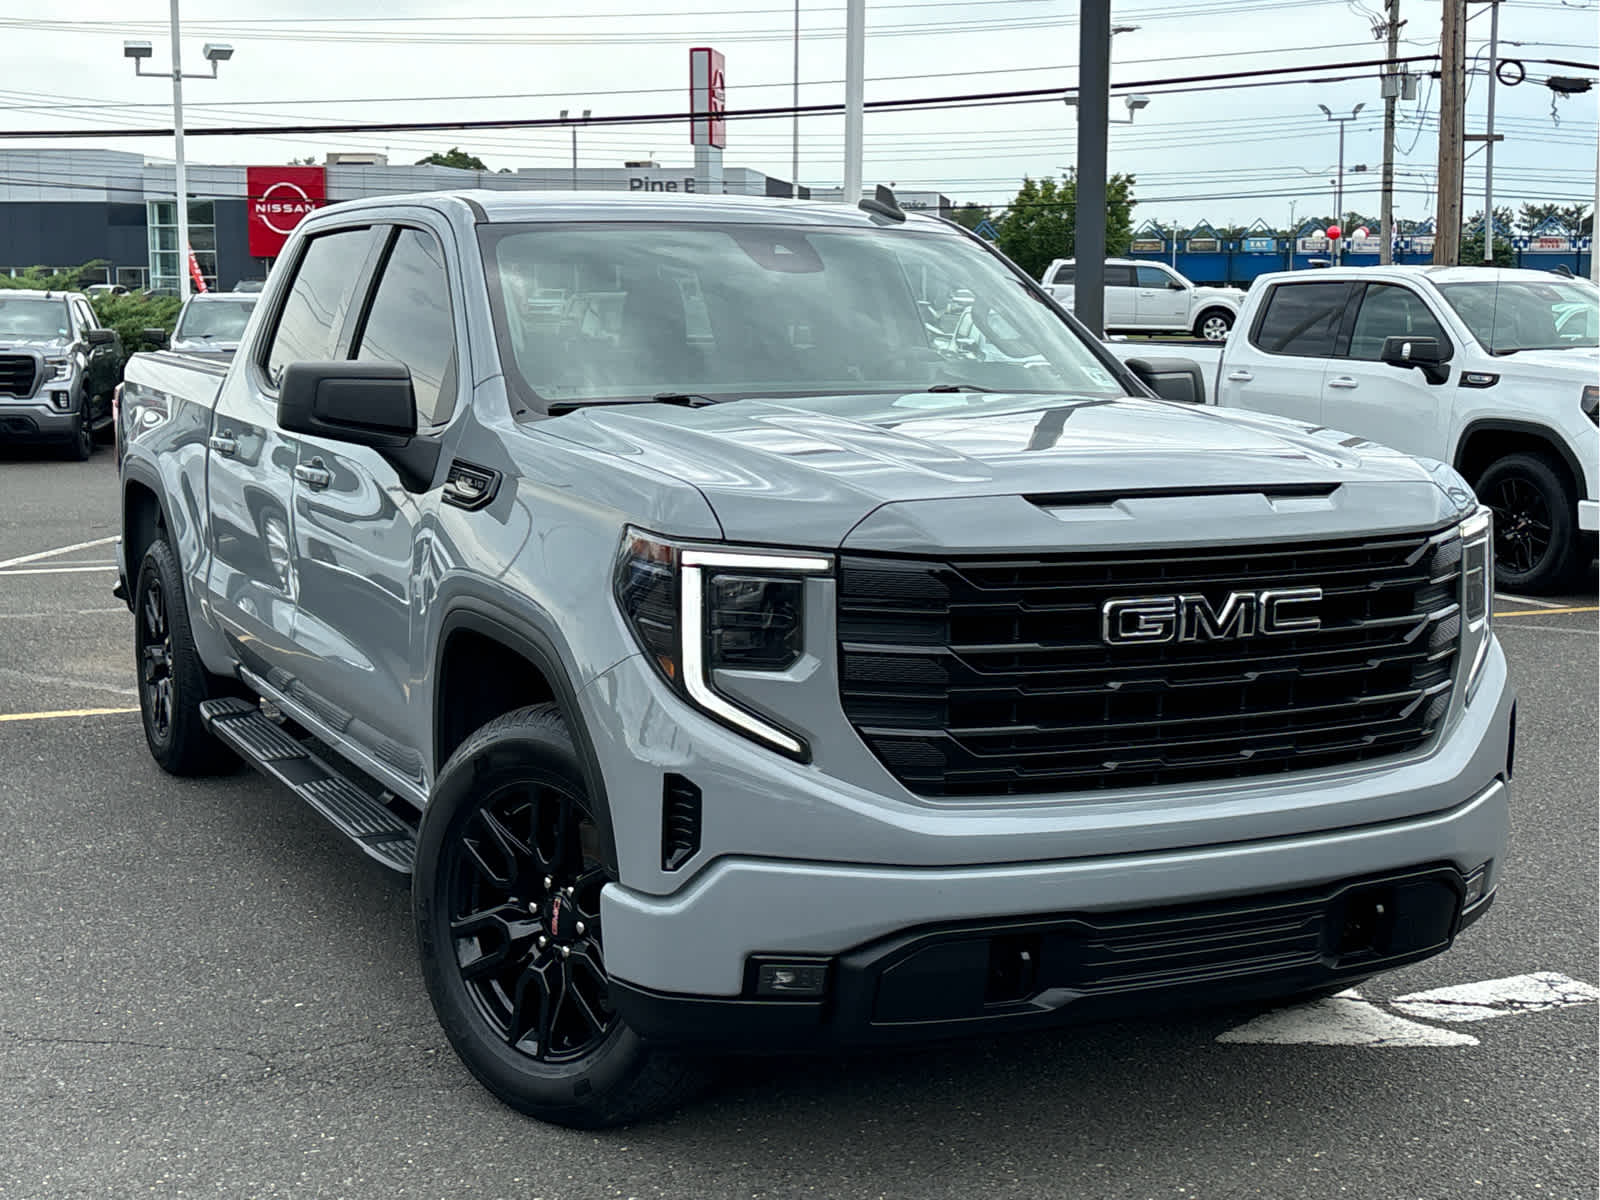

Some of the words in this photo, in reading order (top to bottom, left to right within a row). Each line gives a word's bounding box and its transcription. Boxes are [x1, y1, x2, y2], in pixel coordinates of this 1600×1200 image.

[629, 176, 678, 192] Pine
[255, 203, 315, 213] NISSAN
[1103, 588, 1323, 646] GMC
